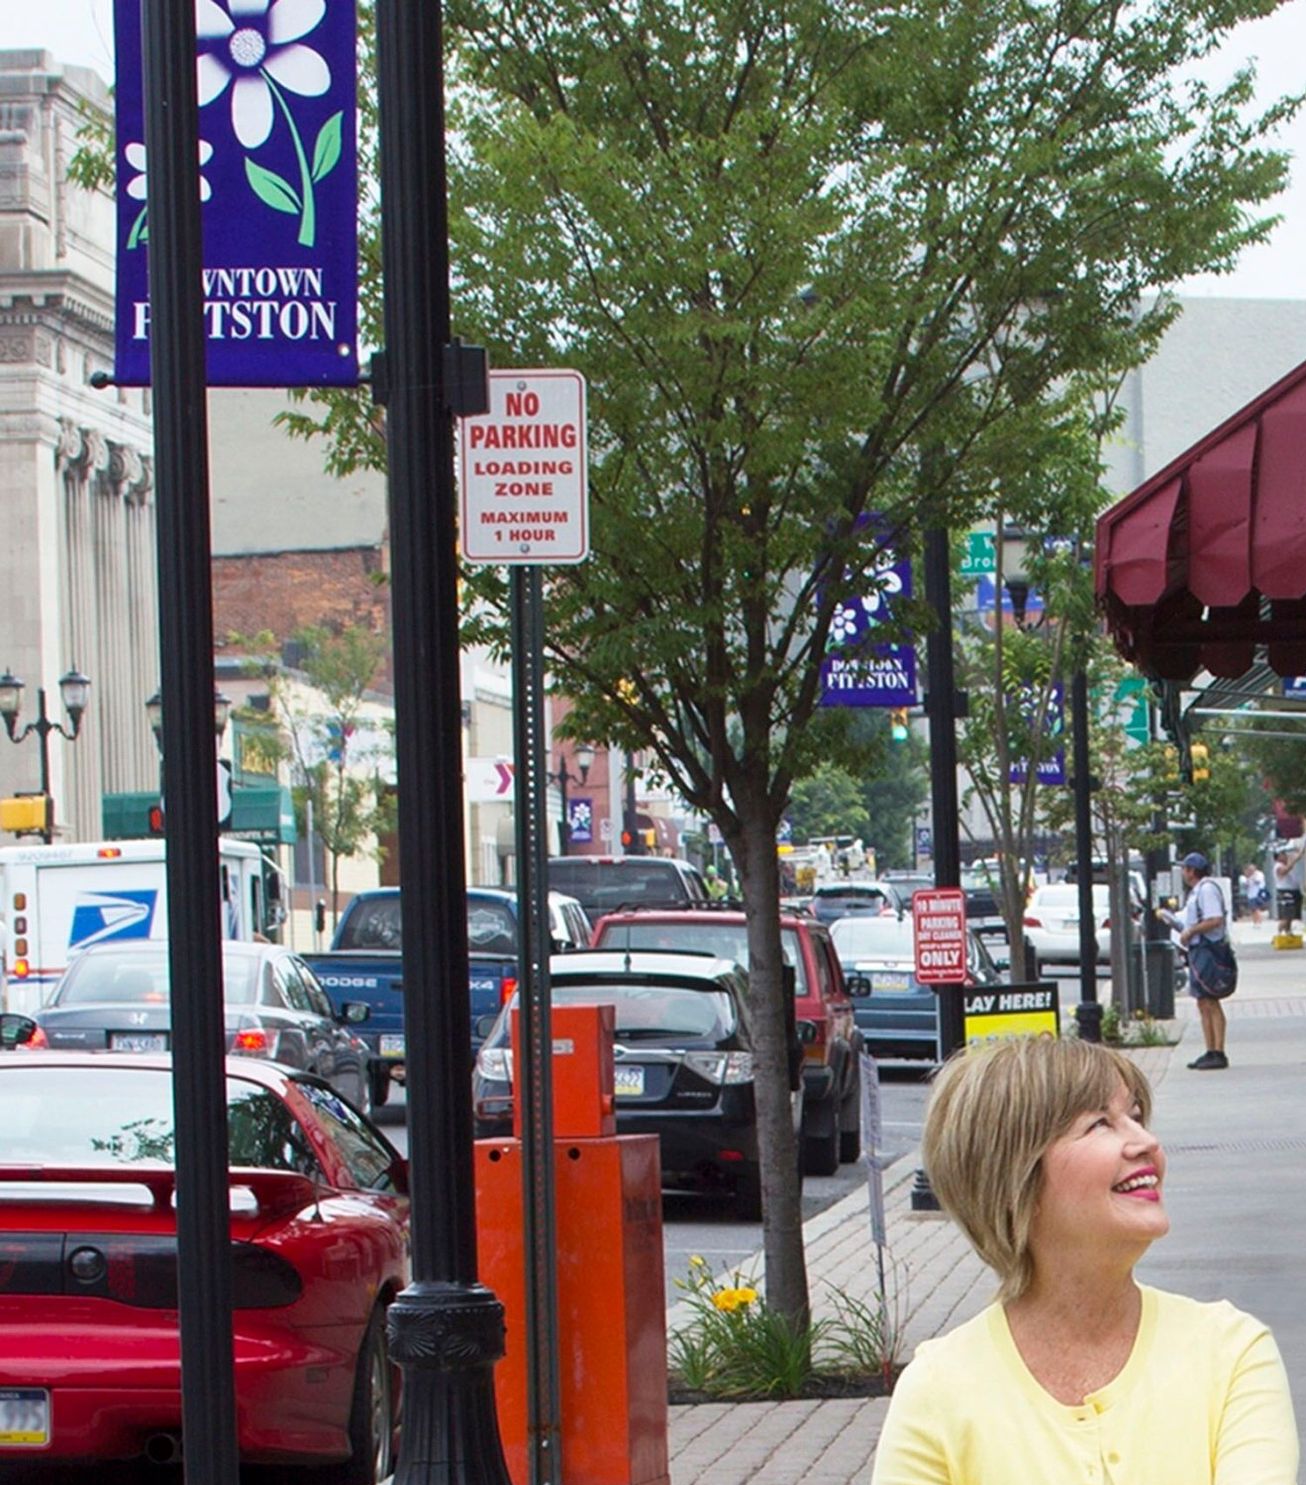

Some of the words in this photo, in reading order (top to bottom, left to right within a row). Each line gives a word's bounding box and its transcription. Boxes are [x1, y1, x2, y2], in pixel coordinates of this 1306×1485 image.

[202, 267, 323, 297] WNTOWN
[133, 300, 337, 340] PTSTON
[505, 391, 540, 417] NO
[470, 423, 577, 449] PARKING
[474, 461, 573, 476] LOADING
[495, 482, 554, 496] ZONE
[480, 511, 569, 524] MAXIMUM
[494, 530, 503, 542] 1
[509, 529, 556, 541] HOUR
[920, 950, 961, 967] ONLY
[998, 991, 1051, 1010] HERE!
